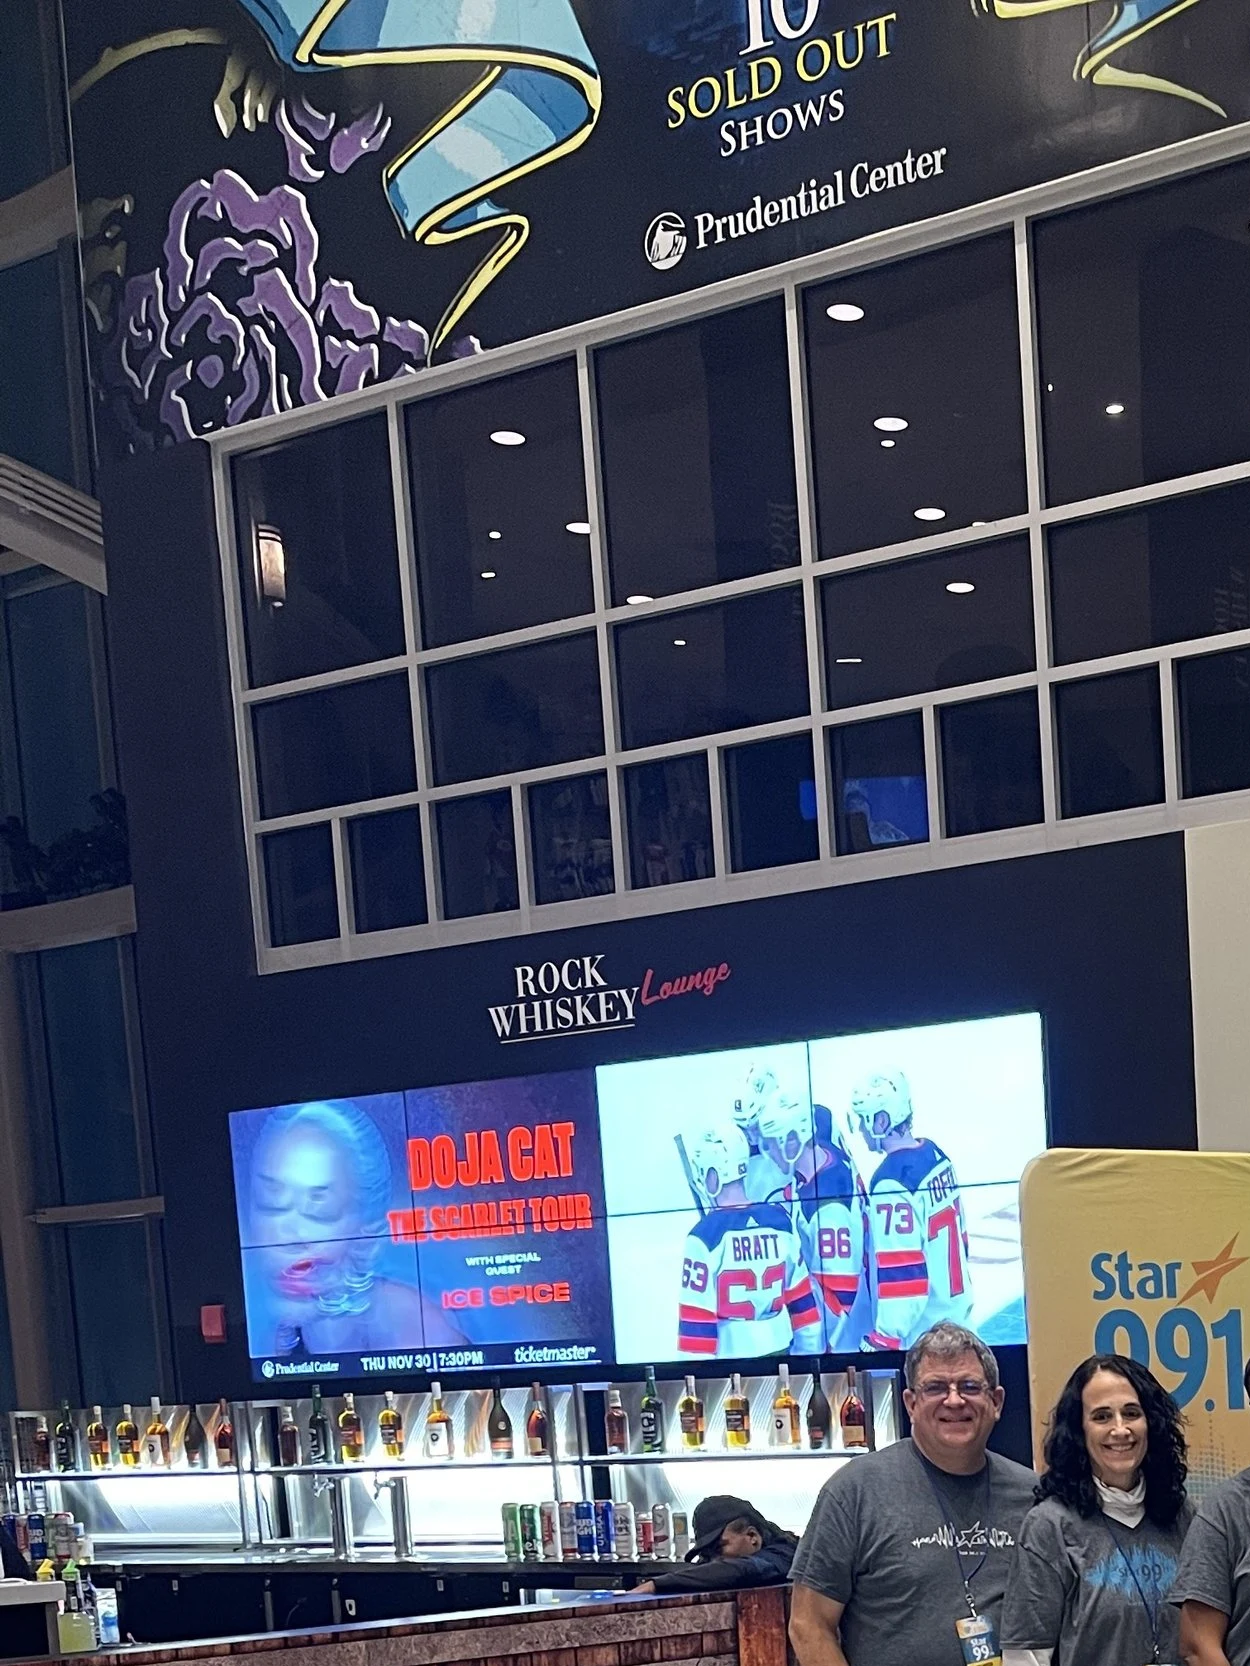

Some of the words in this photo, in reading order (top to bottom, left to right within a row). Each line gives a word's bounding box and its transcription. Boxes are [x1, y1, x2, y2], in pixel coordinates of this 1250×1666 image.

[667, 56, 782, 129] SOLD
[796, 13, 896, 82] OUT
[720, 89, 844, 156] SHOWS
[694, 170, 845, 249] Prudential
[850, 147, 947, 198] Center
[514, 954, 608, 998] ROCK
[487, 986, 640, 1038] WHISKEY
[640, 962, 732, 1006] Lounge
[407, 1130, 505, 1192] DOJA
[507, 1122, 575, 1182] CAT
[387, 1207, 426, 1244] THE
[429, 1199, 525, 1242] SCARLET
[528, 1193, 593, 1233] TOUR
[876, 1202, 914, 1235] 73
[465, 1255, 494, 1267] WITH
[495, 1252, 541, 1264] SPECIAL
[732, 1234, 779, 1262] BRATT
[818, 1227, 851, 1258] 86
[927, 1197, 967, 1299] 7
[485, 1264, 522, 1276] GUEST
[682, 1258, 709, 1293] 63
[1091, 1250, 1182, 1300] Star
[442, 1286, 484, 1309] ICE
[489, 1281, 571, 1307] SPICE
[275, 1361, 314, 1375] Prudential
[314, 1361, 339, 1373] Center
[360, 1356, 385, 1372] THU
[388, 1354, 414, 1370] NOV
[415, 1353, 432, 1369] 30
[439, 1351, 484, 1367] 7:30PM
[514, 1345, 593, 1363] ticketmaster
